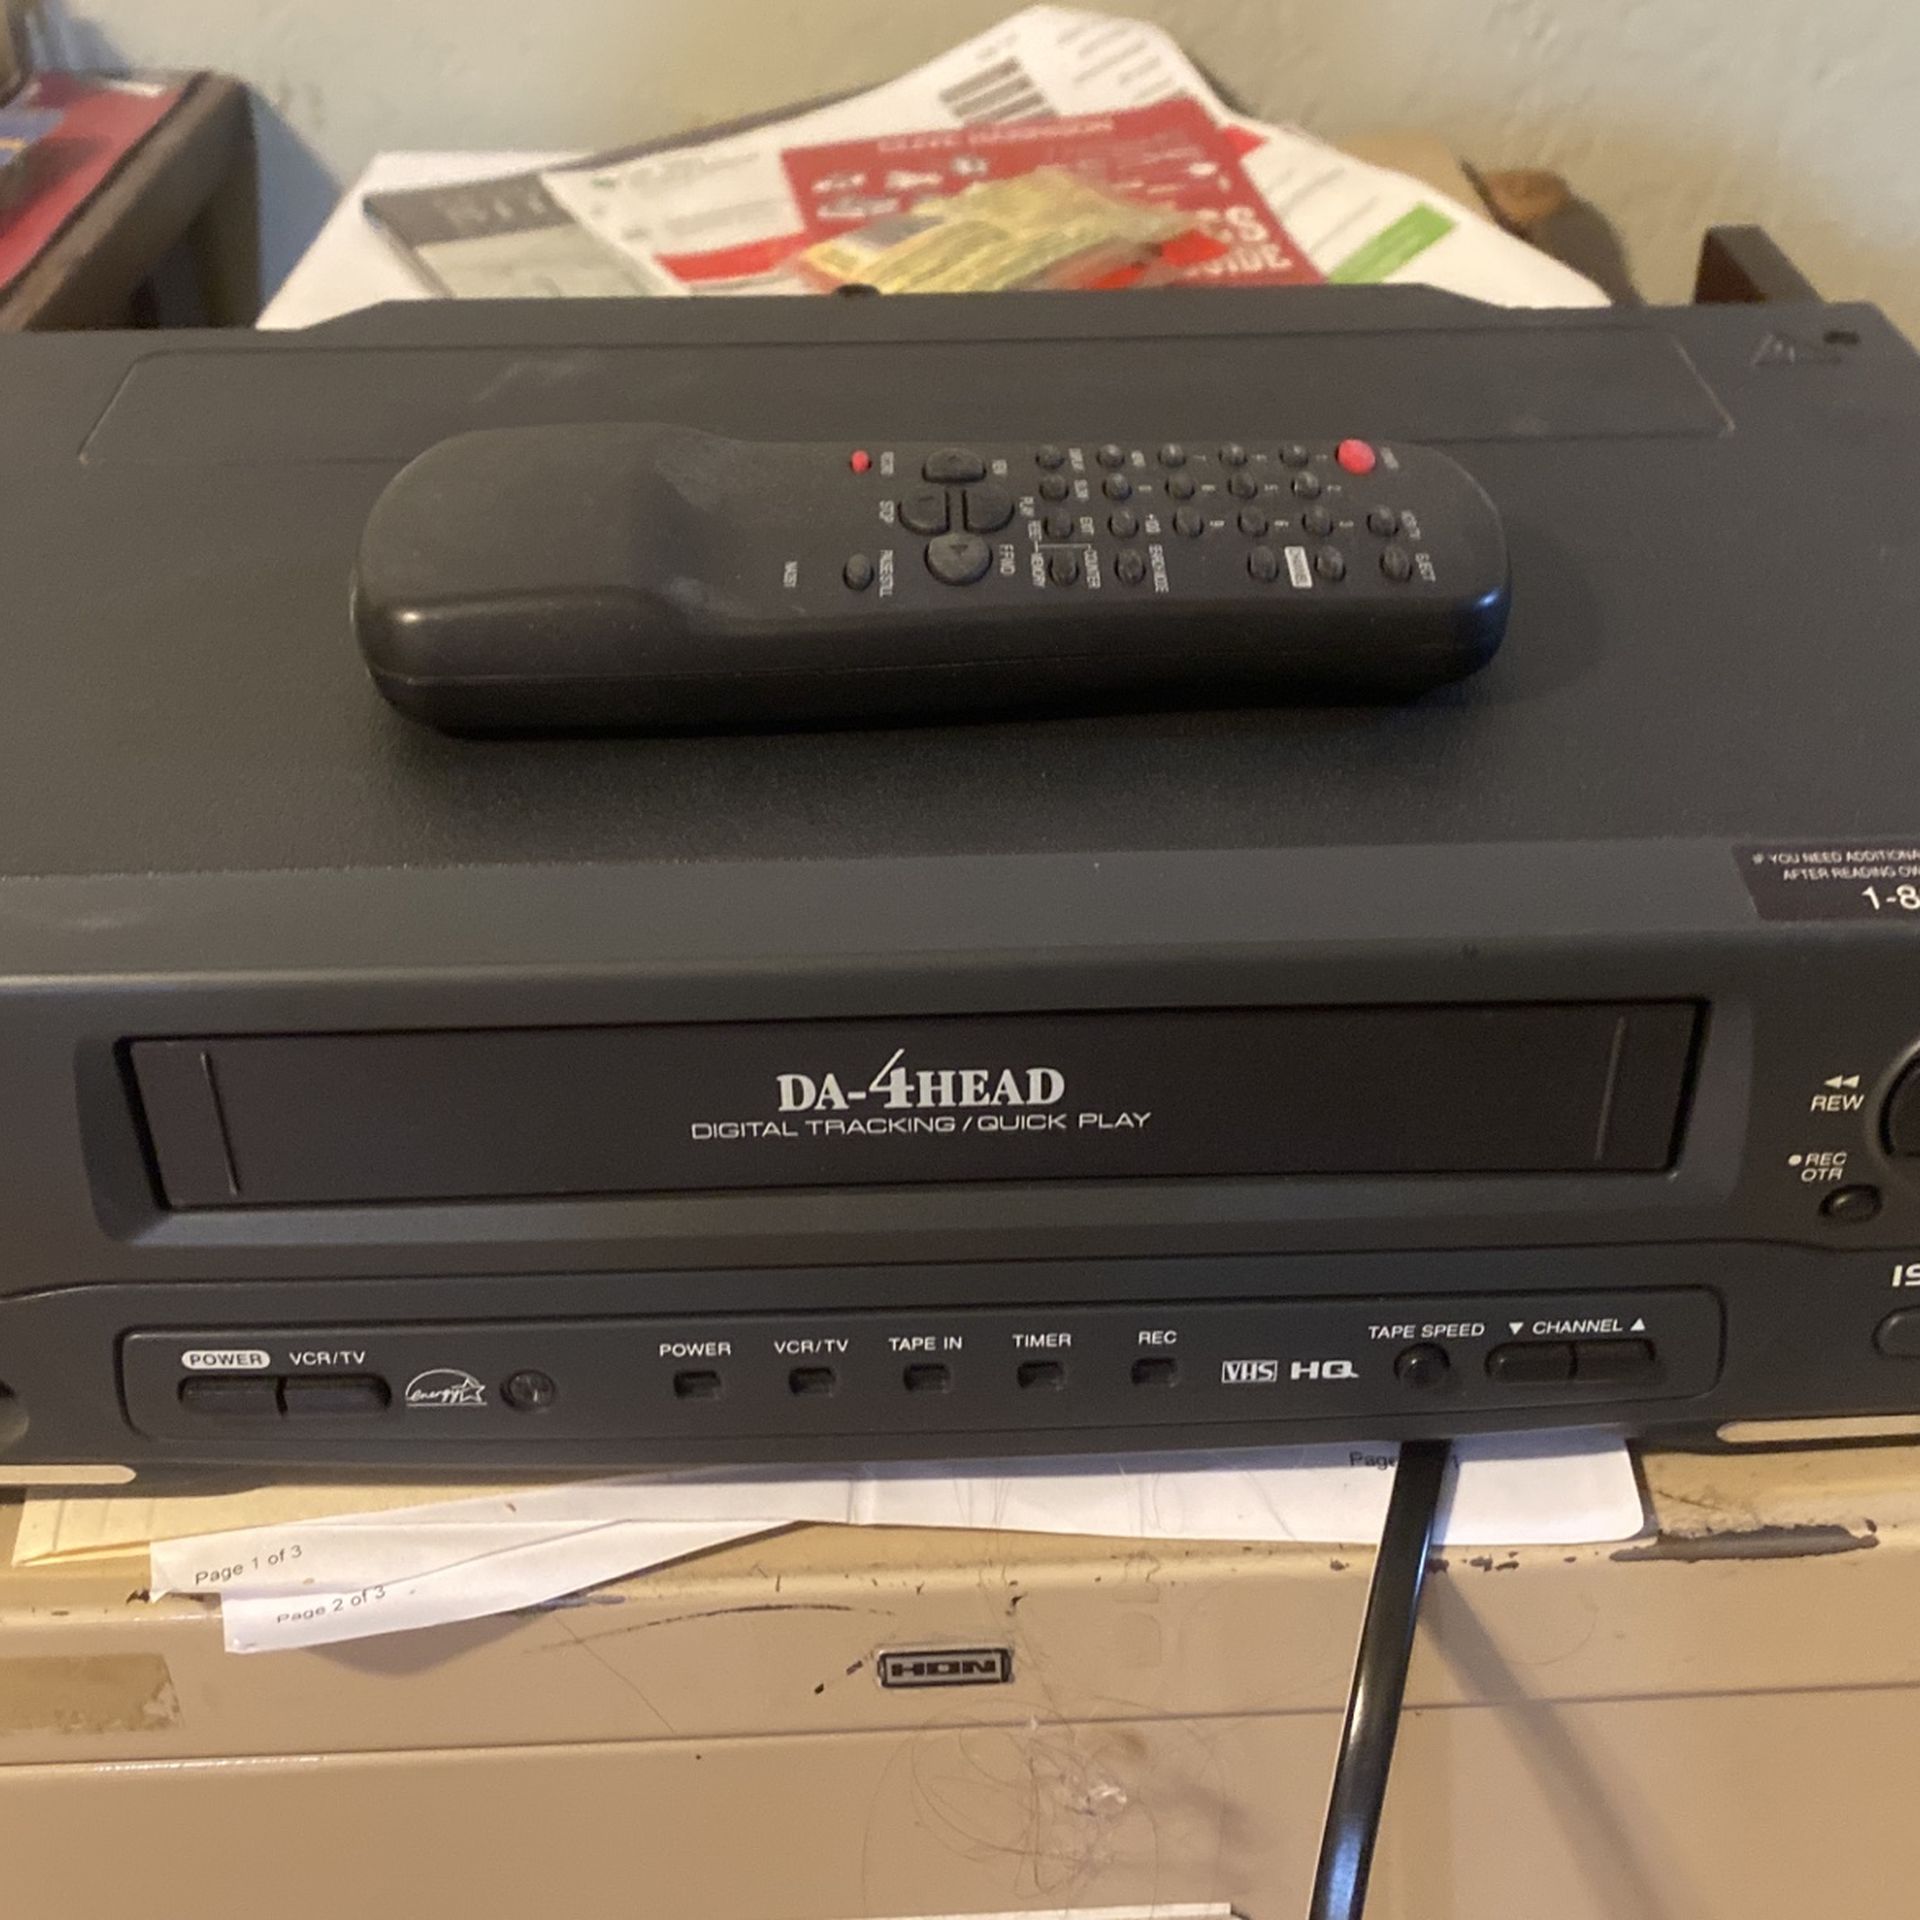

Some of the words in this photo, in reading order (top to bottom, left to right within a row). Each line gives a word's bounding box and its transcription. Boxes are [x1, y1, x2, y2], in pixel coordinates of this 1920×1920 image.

[879, 500, 895, 524] STOP
[1080, 516, 1094, 536] EXIT
[1084, 549, 1101, 589] COUNTER
[1769, 853, 1800, 864] YOU
[1802, 851, 1842, 864] NEED
[1784, 867, 1828, 880] AFTER
[1831, 865, 1896, 879] READING
[1862, 884, 1920, 910] 1-8
[777, 1049, 1065, 1111] DA-4HEAD
[1810, 1095, 1864, 1112] REW
[692, 1121, 798, 1139] DIGITAL
[1079, 1111, 1151, 1129] PLAY
[1805, 1151, 1847, 1167] REC
[1801, 1167, 1843, 1182] OTR
[1369, 1325, 1415, 1339] TAPE
[1421, 1323, 1485, 1337] SPEED
[1532, 1318, 1623, 1335] CHANNEL
[774, 1339, 849, 1354] VCR/TV
[889, 1337, 936, 1351] TAPE
[944, 1337, 963, 1350] IN
[1012, 1333, 1072, 1348] TIMER
[1138, 1331, 1177, 1345] REC
[659, 1342, 731, 1357] POWER
[190, 1353, 263, 1366] POWER
[289, 1351, 366, 1366] VCR/TV
[1224, 1361, 1276, 1382] VHS
[1291, 1361, 1359, 1380] HQ
[195, 1564, 243, 1585] Page
[252, 1557, 260, 1569] 1
[268, 1548, 286, 1566] of
[291, 1545, 302, 1558] 3
[277, 1605, 326, 1623] Page
[333, 1599, 343, 1612] 2
[350, 1587, 368, 1606] of
[375, 1584, 386, 1599] 3
[891, 1660, 996, 1677] HON
